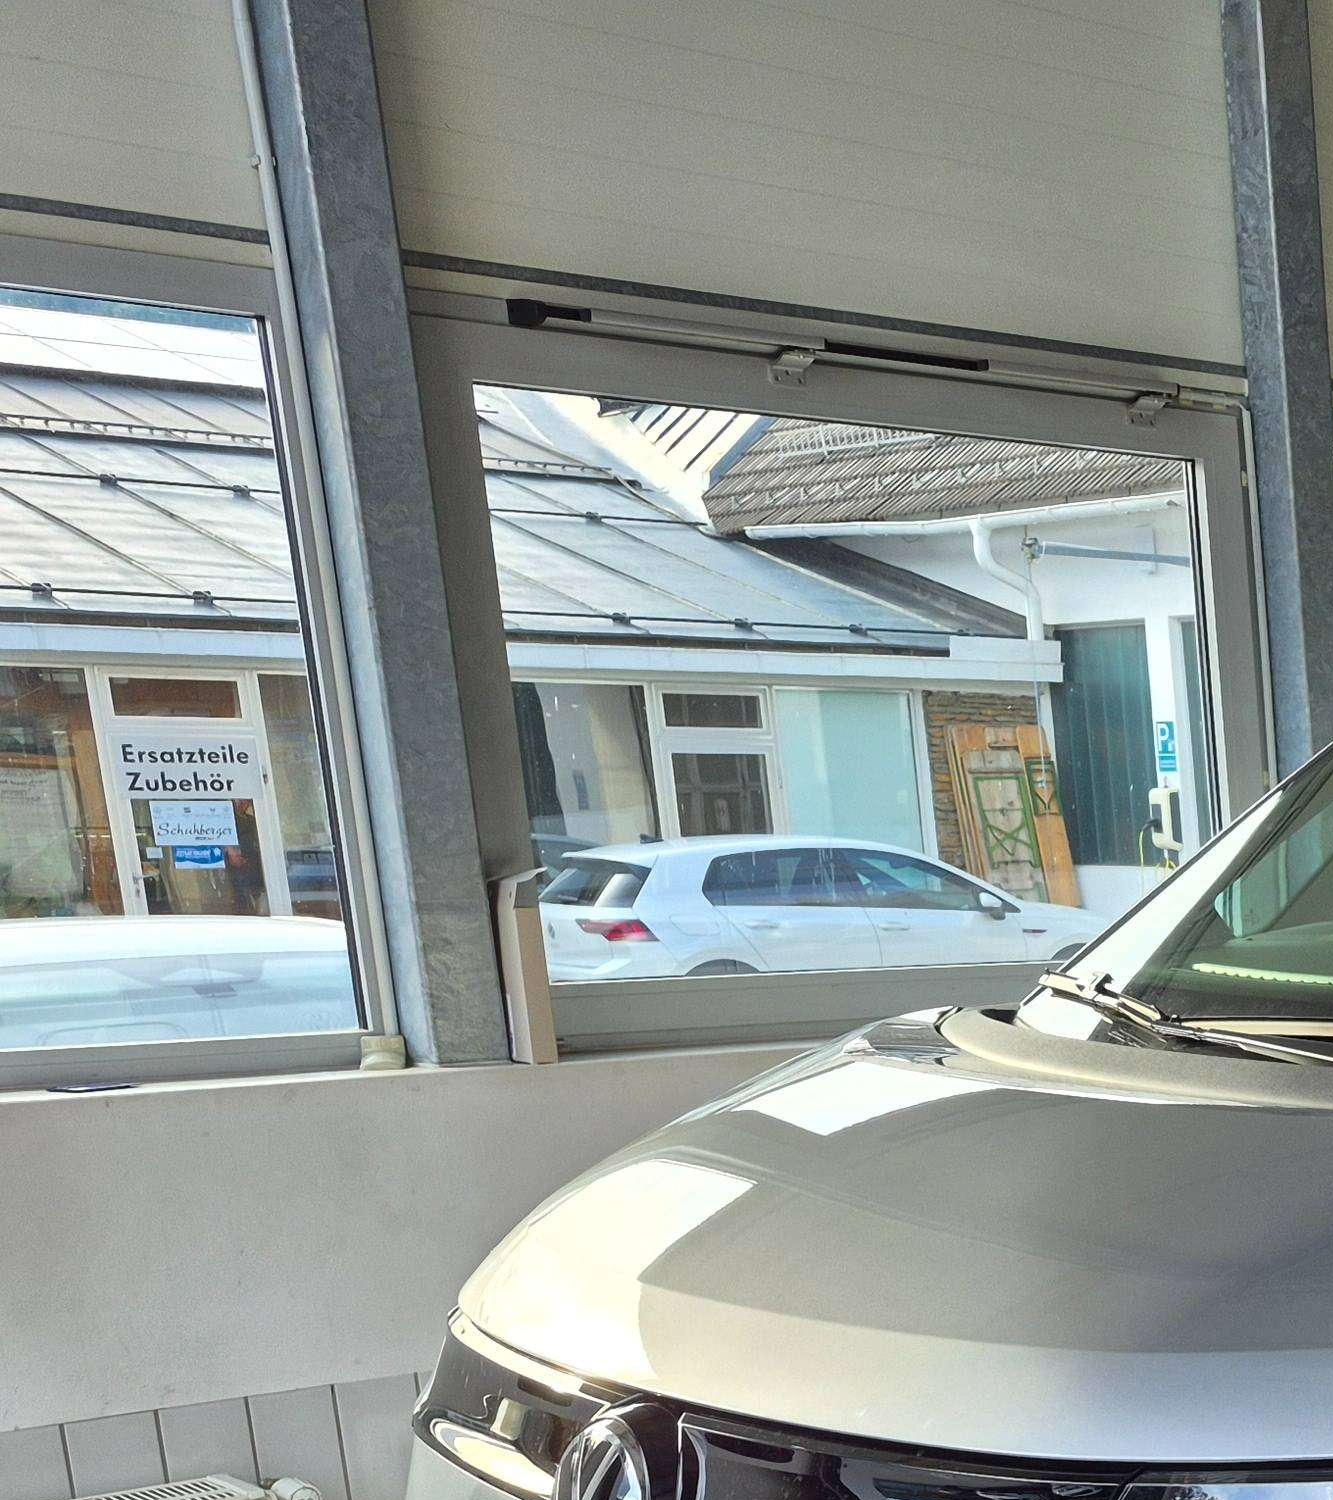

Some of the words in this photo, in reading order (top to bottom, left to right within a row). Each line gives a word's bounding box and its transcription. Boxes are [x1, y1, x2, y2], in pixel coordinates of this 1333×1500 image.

[1156, 723, 1169, 751] P
[121, 743, 249, 764] Ersatzteile
[125, 771, 235, 792] Zubehör
[156, 822, 233, 840] Schuhberger
